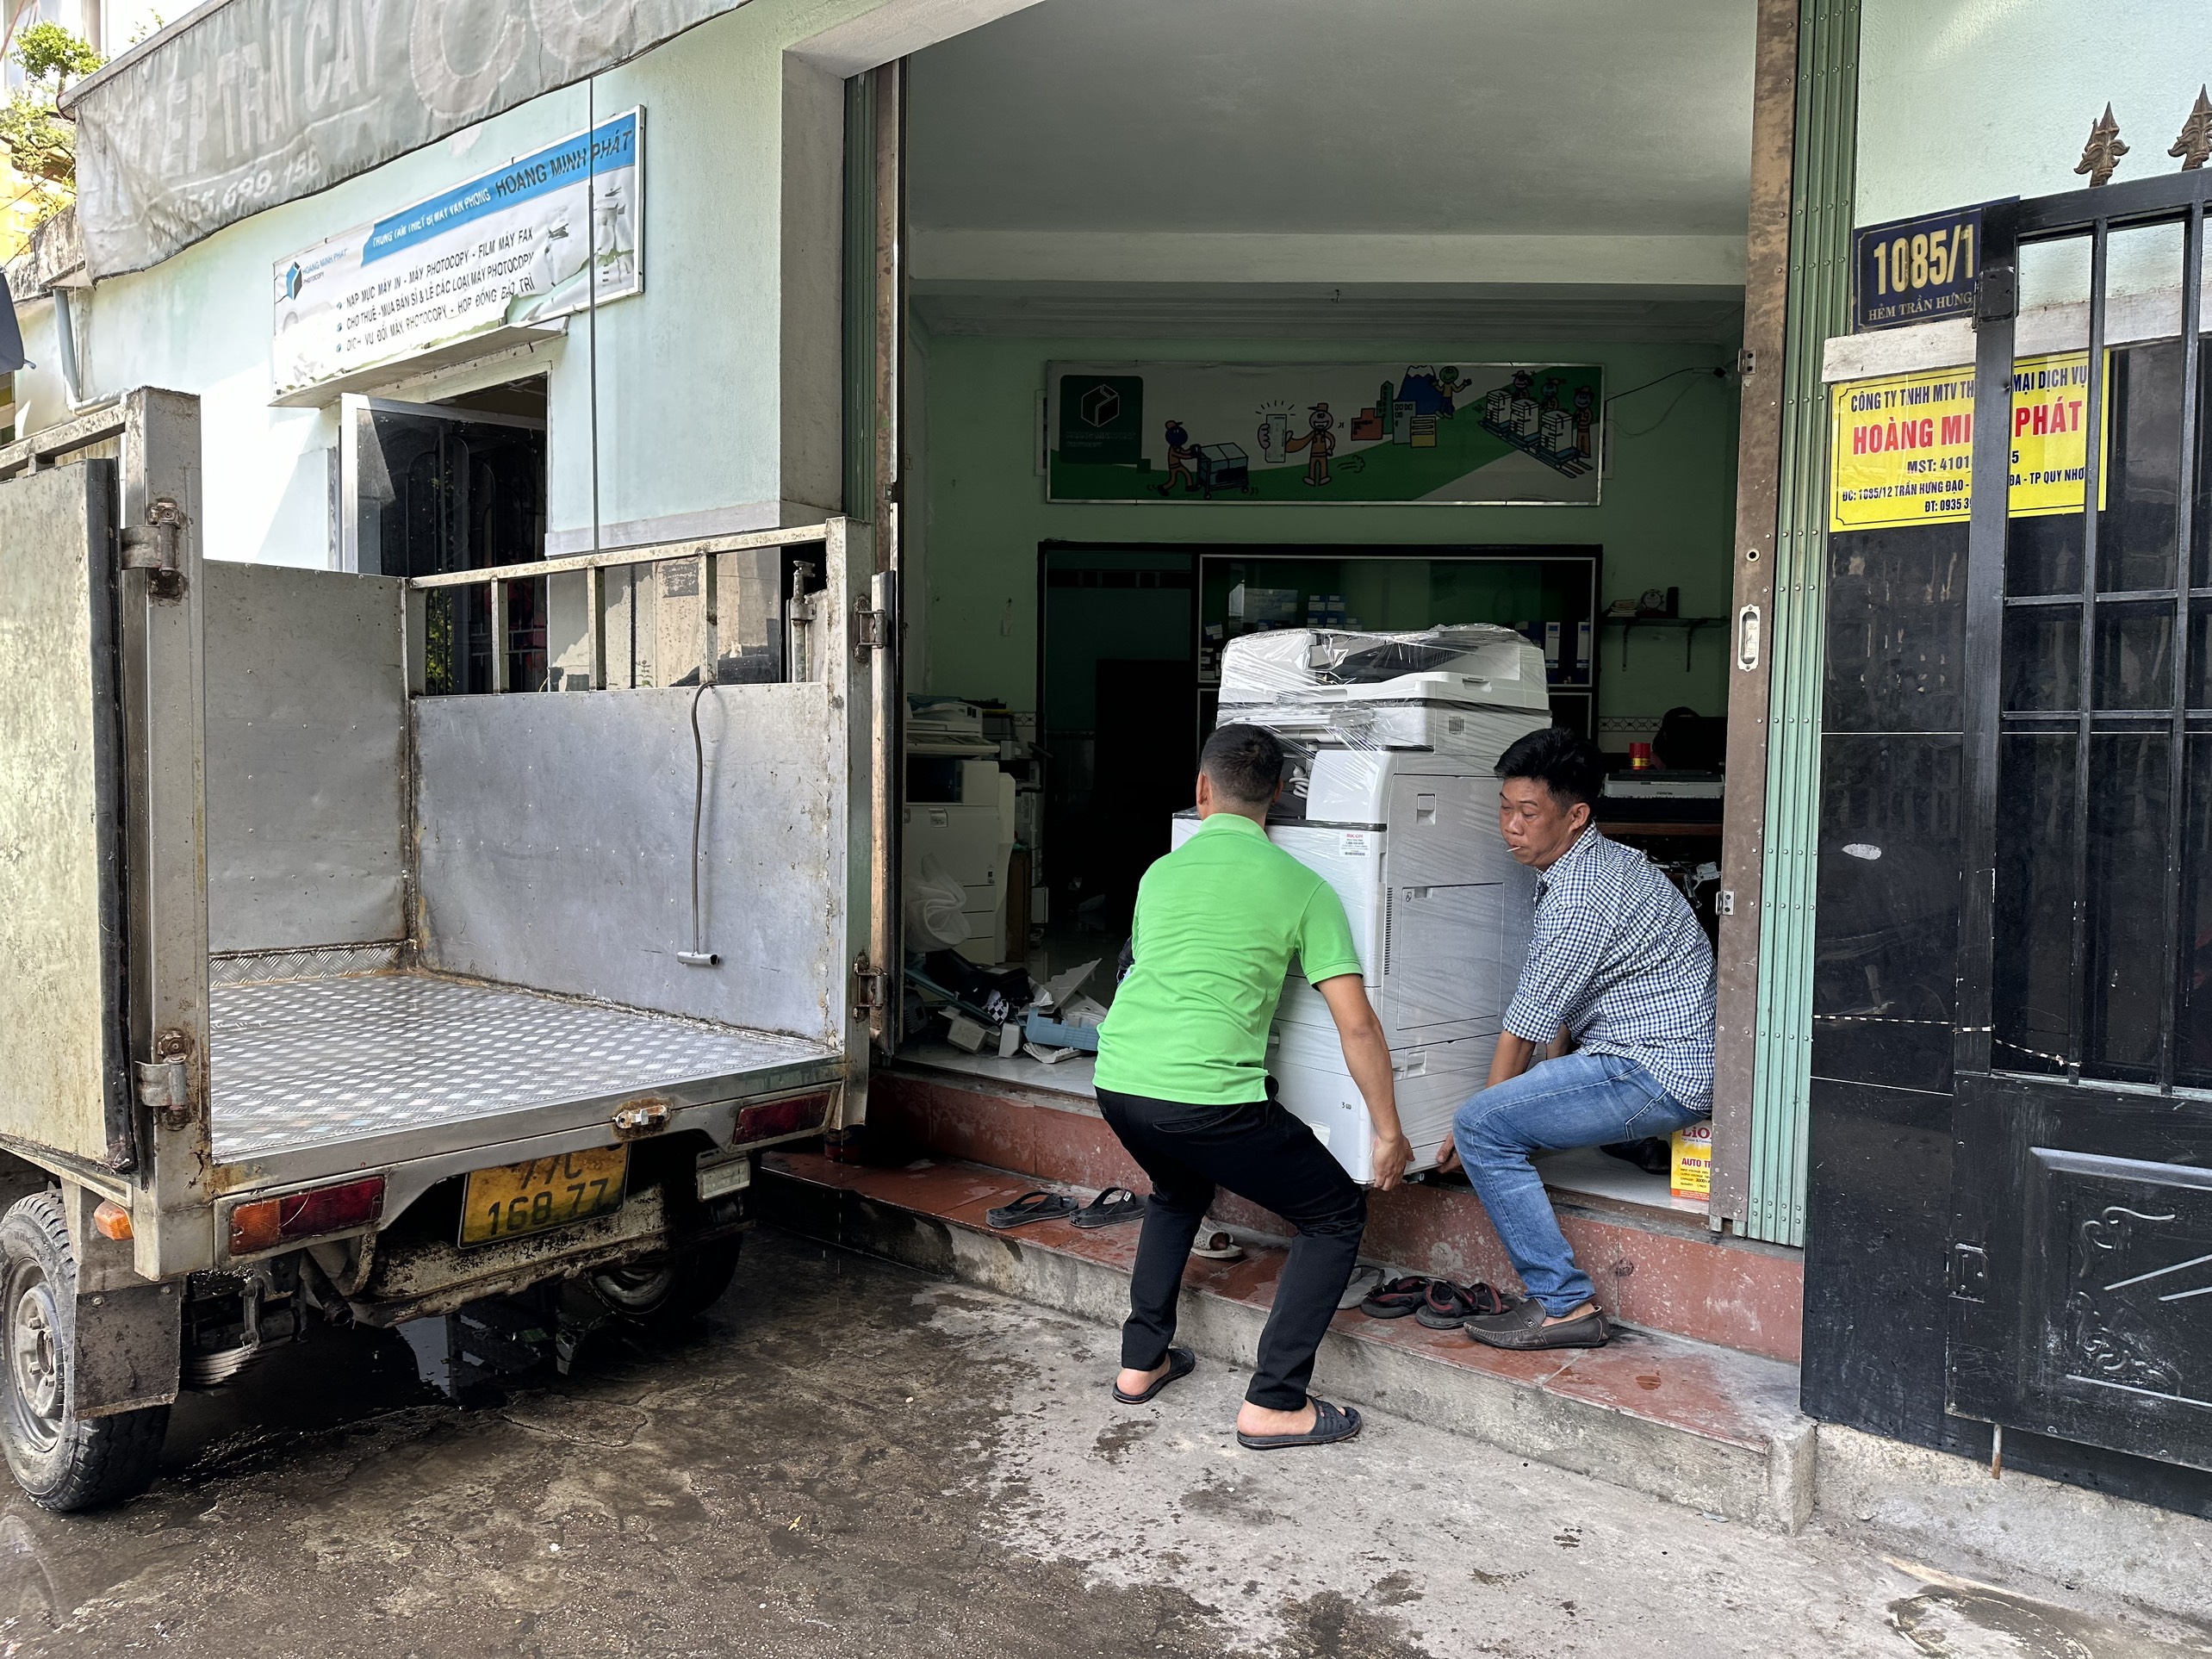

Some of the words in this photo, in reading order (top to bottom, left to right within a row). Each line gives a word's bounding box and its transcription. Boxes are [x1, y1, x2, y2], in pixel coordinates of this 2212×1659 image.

[373, 230, 394, 248] TRUNG
[550, 147, 587, 178] MINH
[592, 129, 632, 162] PHÁT
[377, 276, 392, 296] MÁY
[394, 275, 401, 290] IN
[408, 265, 424, 284] MÁY
[426, 249, 469, 278] PHOTOCOPY
[478, 239, 495, 258] FILM
[499, 230, 515, 251] MÁY
[518, 227, 533, 245] FAX
[346, 314, 360, 330] CHO
[381, 300, 396, 318] MUA
[395, 292, 410, 312] BÁN
[436, 277, 450, 297] CÁC
[470, 264, 486, 285] MÁY
[487, 251, 534, 280] PHOTOCOPY
[1867, 303, 1896, 321] HẺM
[1898, 295, 1933, 314] TRẦN
[1936, 291, 1973, 309] HƯNG
[389, 318, 404, 337] MÁY
[406, 304, 448, 331] PHOTOCOPY
[1850, 390, 1881, 413] CÔNG
[1884, 389, 1898, 408] TY
[1899, 385, 1929, 407] TNHH
[1932, 382, 1957, 402] MTV
[2013, 371, 2035, 395] MẠI
[2038, 367, 2068, 393] DỊCH
[2071, 365, 2088, 388] VỤ
[1853, 416, 1934, 456] HOÀNG
[1941, 413, 1971, 446] MI
[2015, 395, 2083, 438] PHÁT
[1906, 458, 1937, 474] MST:
[1858, 486, 1892, 500] 1085/12
[1894, 480, 1917, 497] TRẦN
[1919, 481, 1943, 495] HƯNG
[1945, 479, 1964, 494] ĐẠO
[2029, 471, 2041, 485] TP
[2043, 469, 2063, 484] QUY
[2064, 466, 2085, 482] NHƠ
[1924, 500, 1938, 513] ĐT:
[1940, 499, 1962, 511] 0935
[1681, 1126, 1712, 1140] LiO
[1681, 1157, 1702, 1167] AUTO
